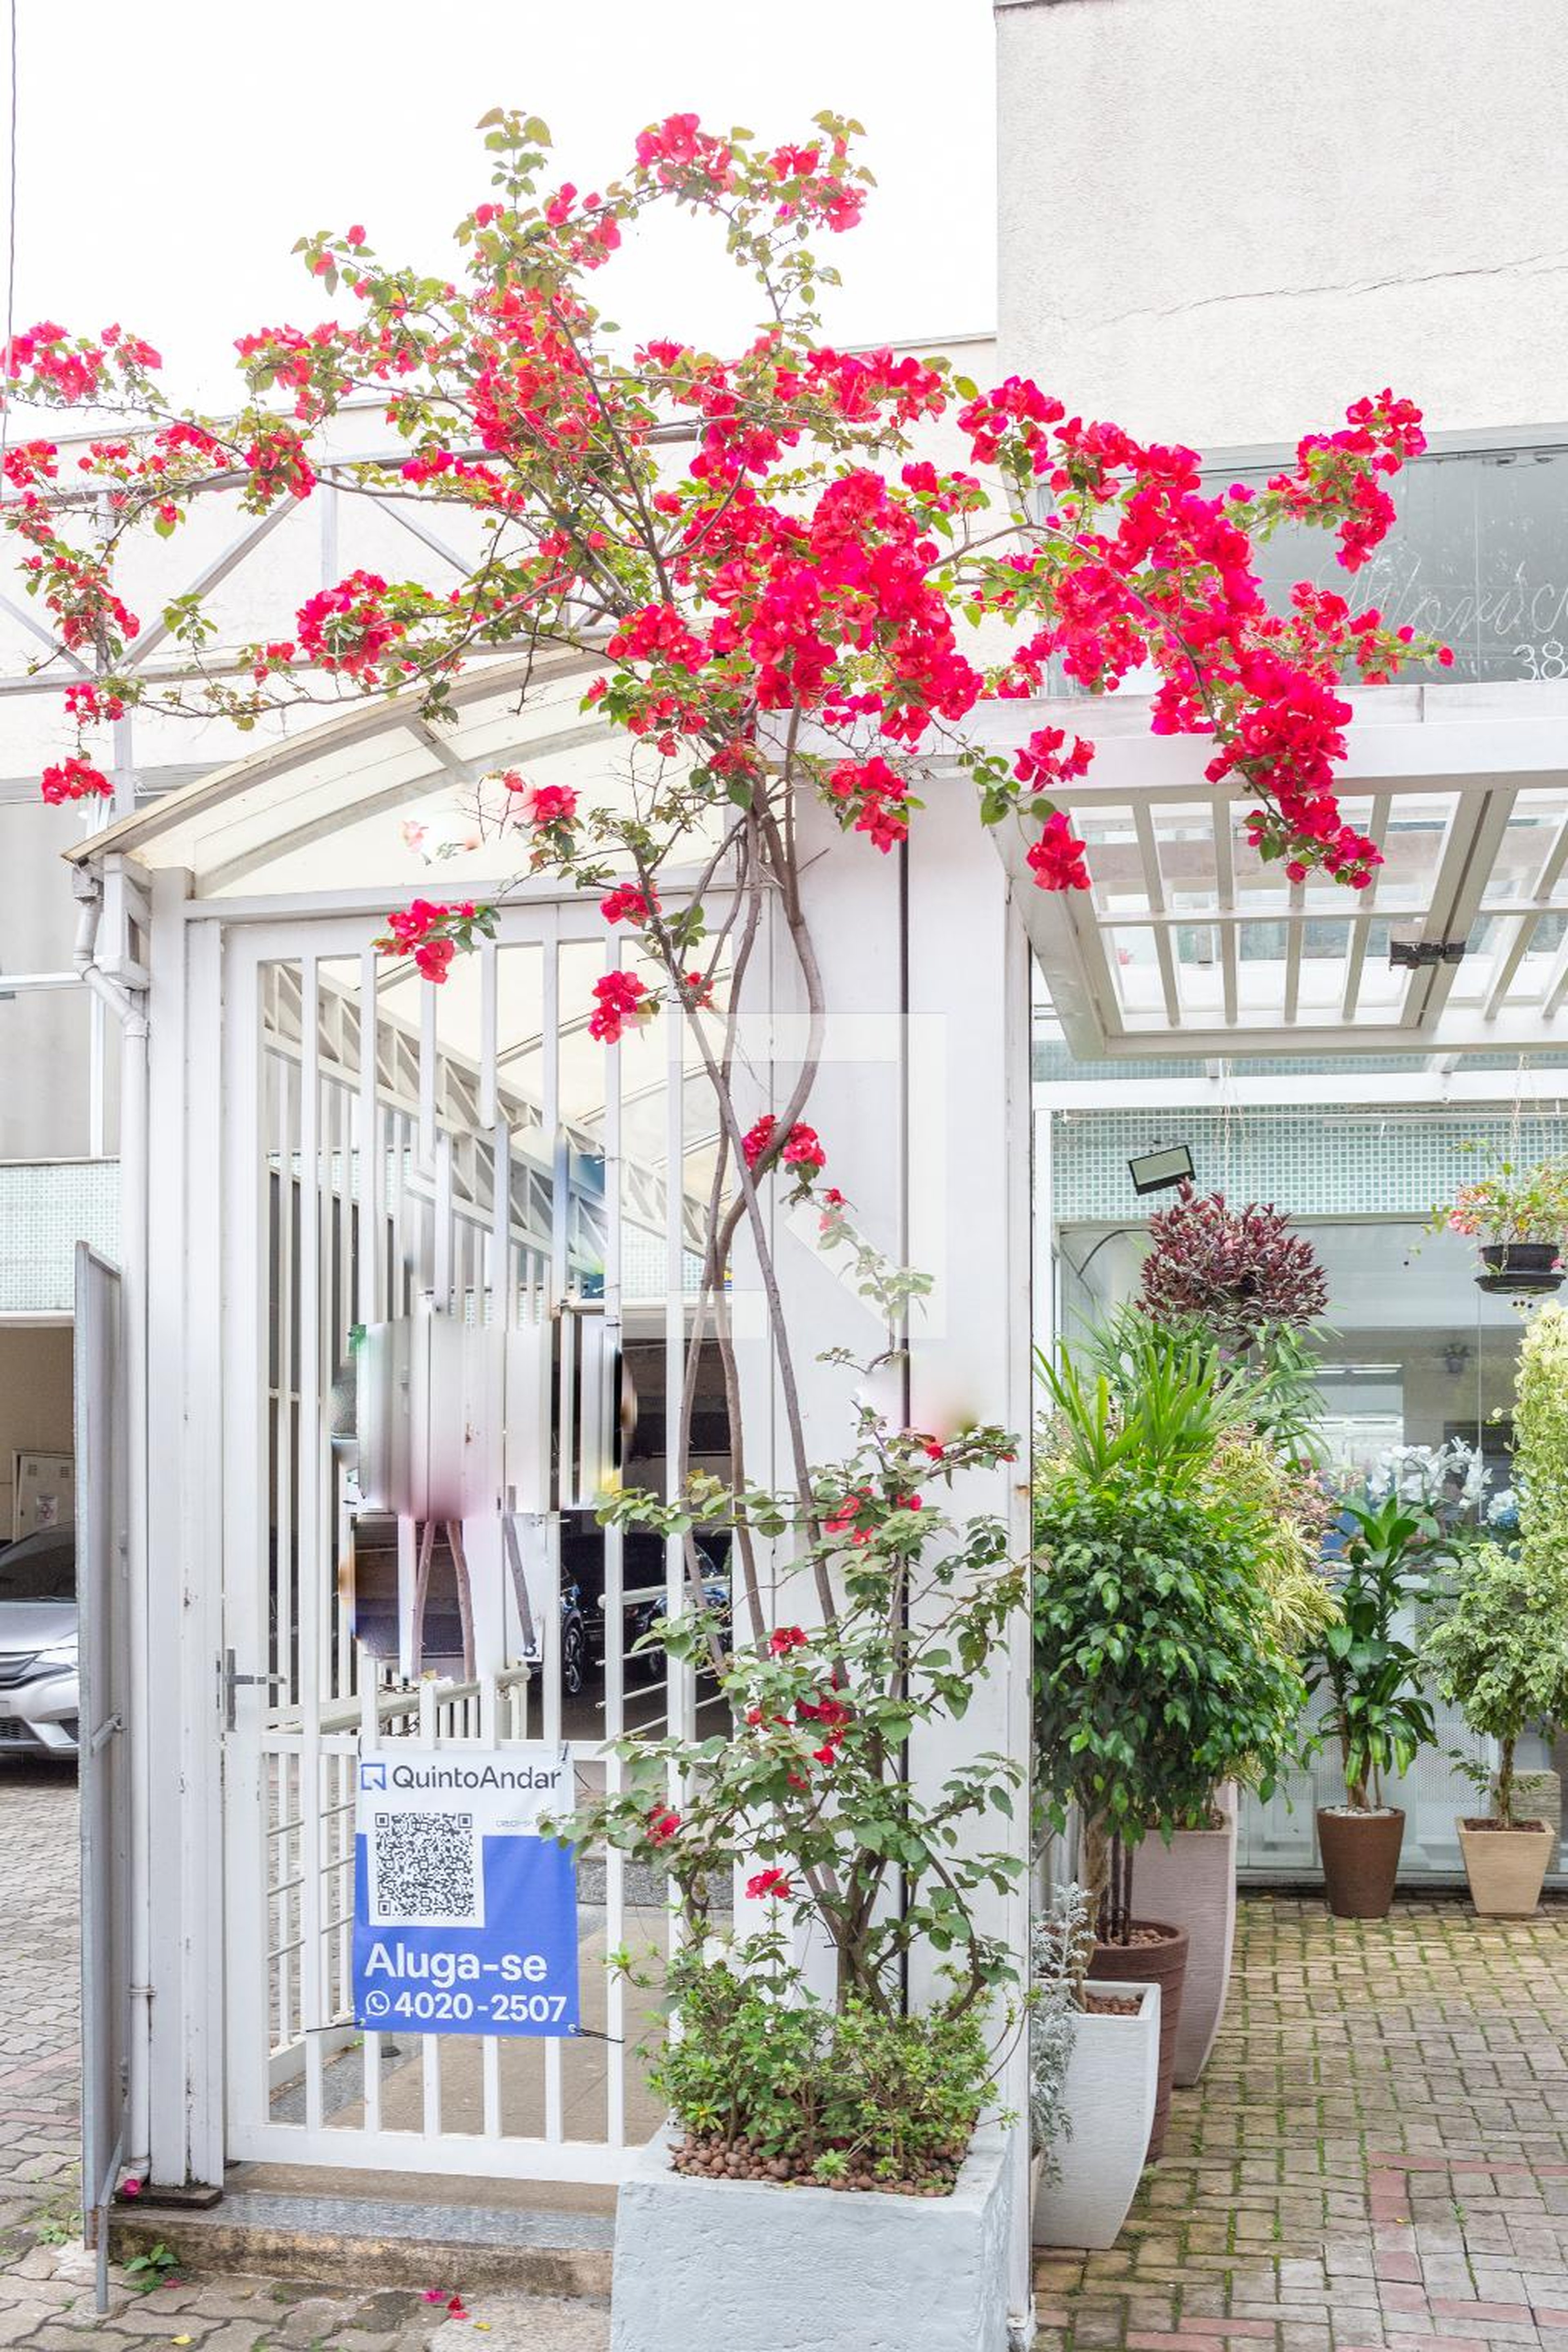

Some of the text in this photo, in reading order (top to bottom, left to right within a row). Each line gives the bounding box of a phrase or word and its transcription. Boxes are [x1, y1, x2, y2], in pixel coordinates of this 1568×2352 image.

[392, 1765, 561, 1790] QuintoAndar
[364, 1942, 548, 1988] Aluga-se
[394, 1991, 567, 2022] 4020-2507
